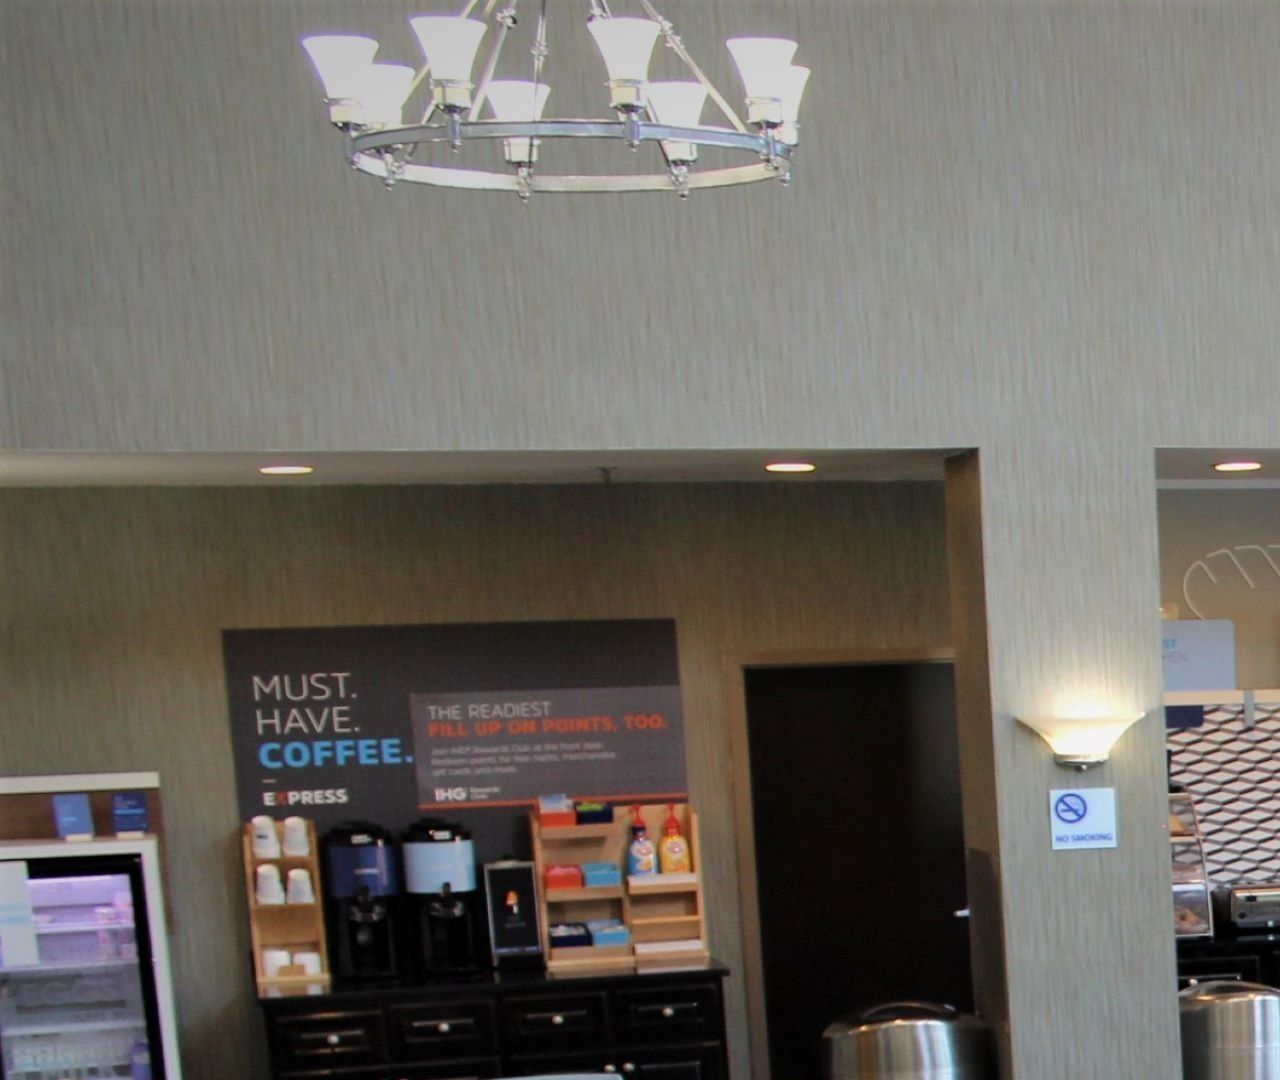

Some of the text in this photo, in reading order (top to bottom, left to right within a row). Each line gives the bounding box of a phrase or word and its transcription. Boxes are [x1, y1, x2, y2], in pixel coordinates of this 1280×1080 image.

[252, 672, 358, 701] MUST.
[427, 701, 552, 720] THE READIEST
[255, 706, 361, 736] HAVE.
[428, 721, 468, 738] FILL
[475, 721, 501, 736] UP
[508, 719, 537, 735] ON
[258, 738, 414, 769] COFFEE.
[262, 788, 349, 806] EXPRESS
[1055, 832, 1113, 843] NO SMOKING
